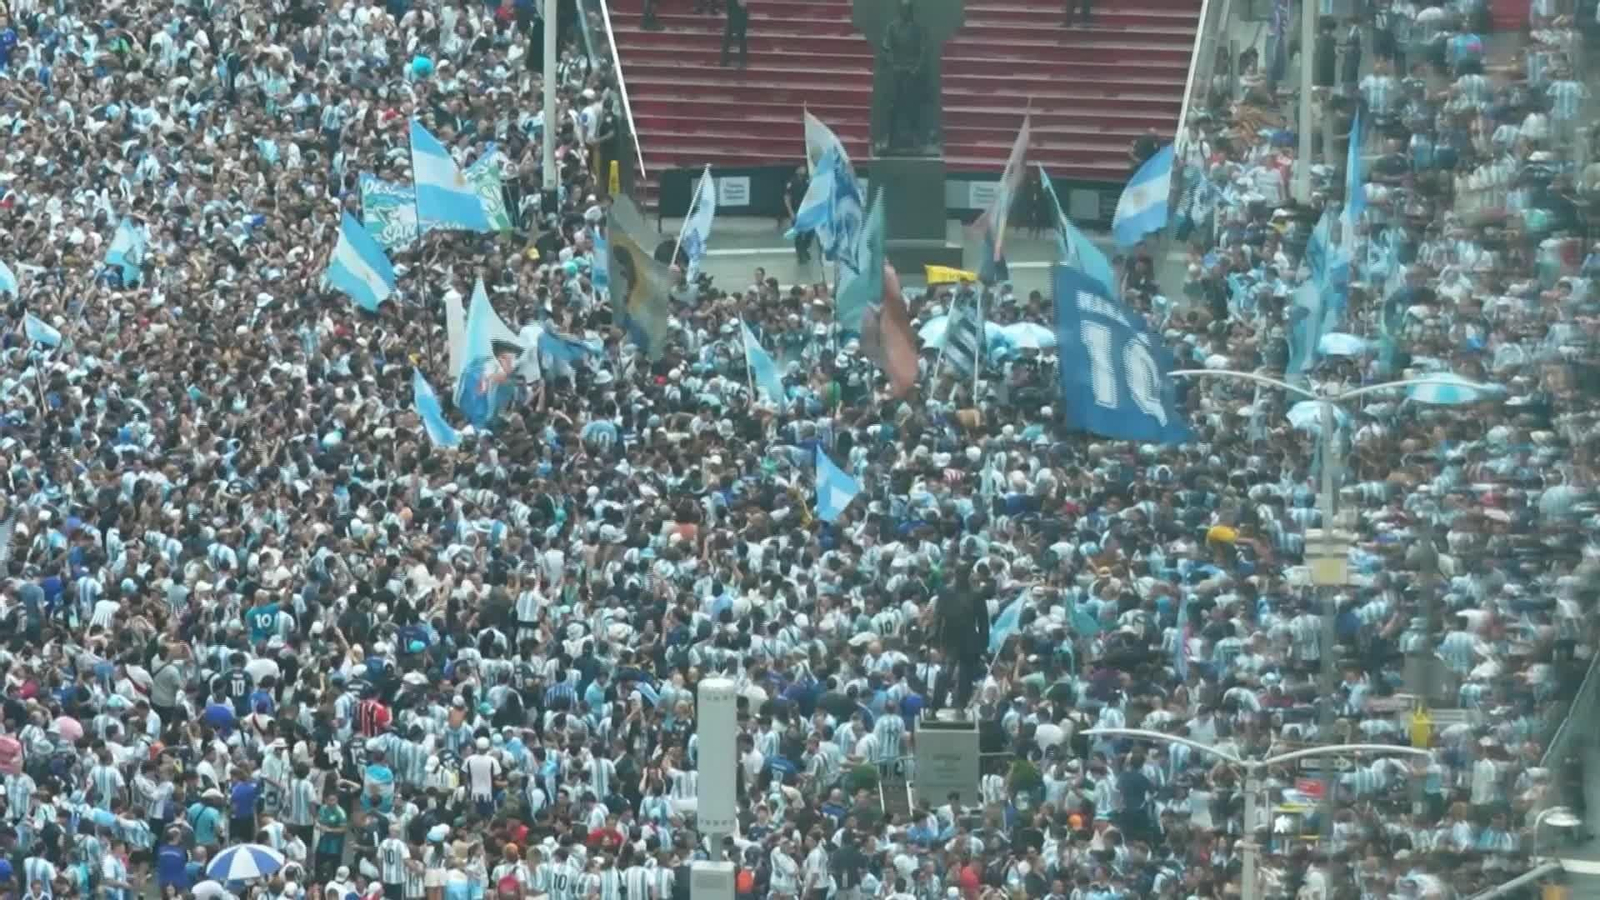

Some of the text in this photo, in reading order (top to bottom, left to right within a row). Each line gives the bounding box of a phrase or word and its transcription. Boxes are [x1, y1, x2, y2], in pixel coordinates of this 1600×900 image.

[1080, 320, 1167, 427] 10
[255, 613, 272, 629] 10
[879, 620, 893, 636] 10
[231, 679, 245, 697] 10
[553, 873, 568, 891] 10
